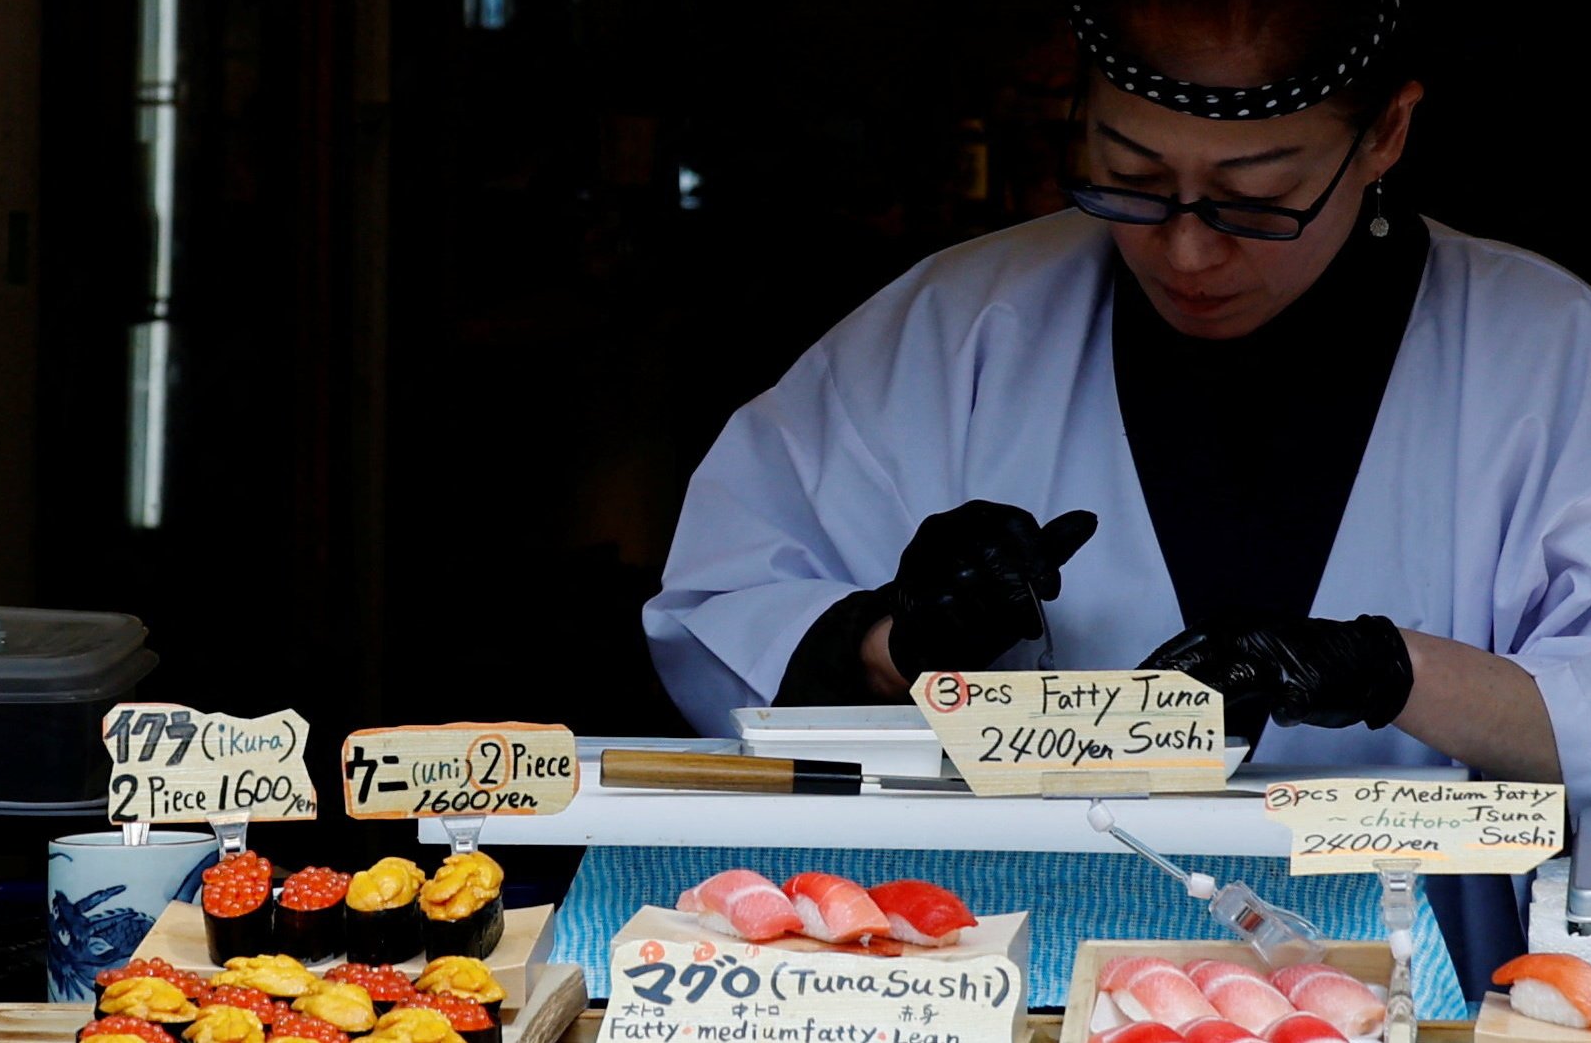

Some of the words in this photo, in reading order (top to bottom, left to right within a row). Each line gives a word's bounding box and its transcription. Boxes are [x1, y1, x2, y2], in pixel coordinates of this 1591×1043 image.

[1040, 675, 1121, 726] Fatty
[1132, 674, 1211, 713] Tuna
[1124, 720, 1215, 755] Sushi
[345, 746, 408, 804] ウニ
[480, 742, 502, 785] 2
[512, 745, 573, 780] Piece
[111, 774, 139, 821] 2
[149, 777, 207, 817] Piece
[1355, 781, 1389, 802] of
[1392, 785, 1487, 803] Medium
[1493, 783, 1558, 807] fatty
[1467, 806, 1546, 823] Tsuna
[1479, 826, 1556, 847] Sushi
[623, 954, 762, 1006] マグロ
